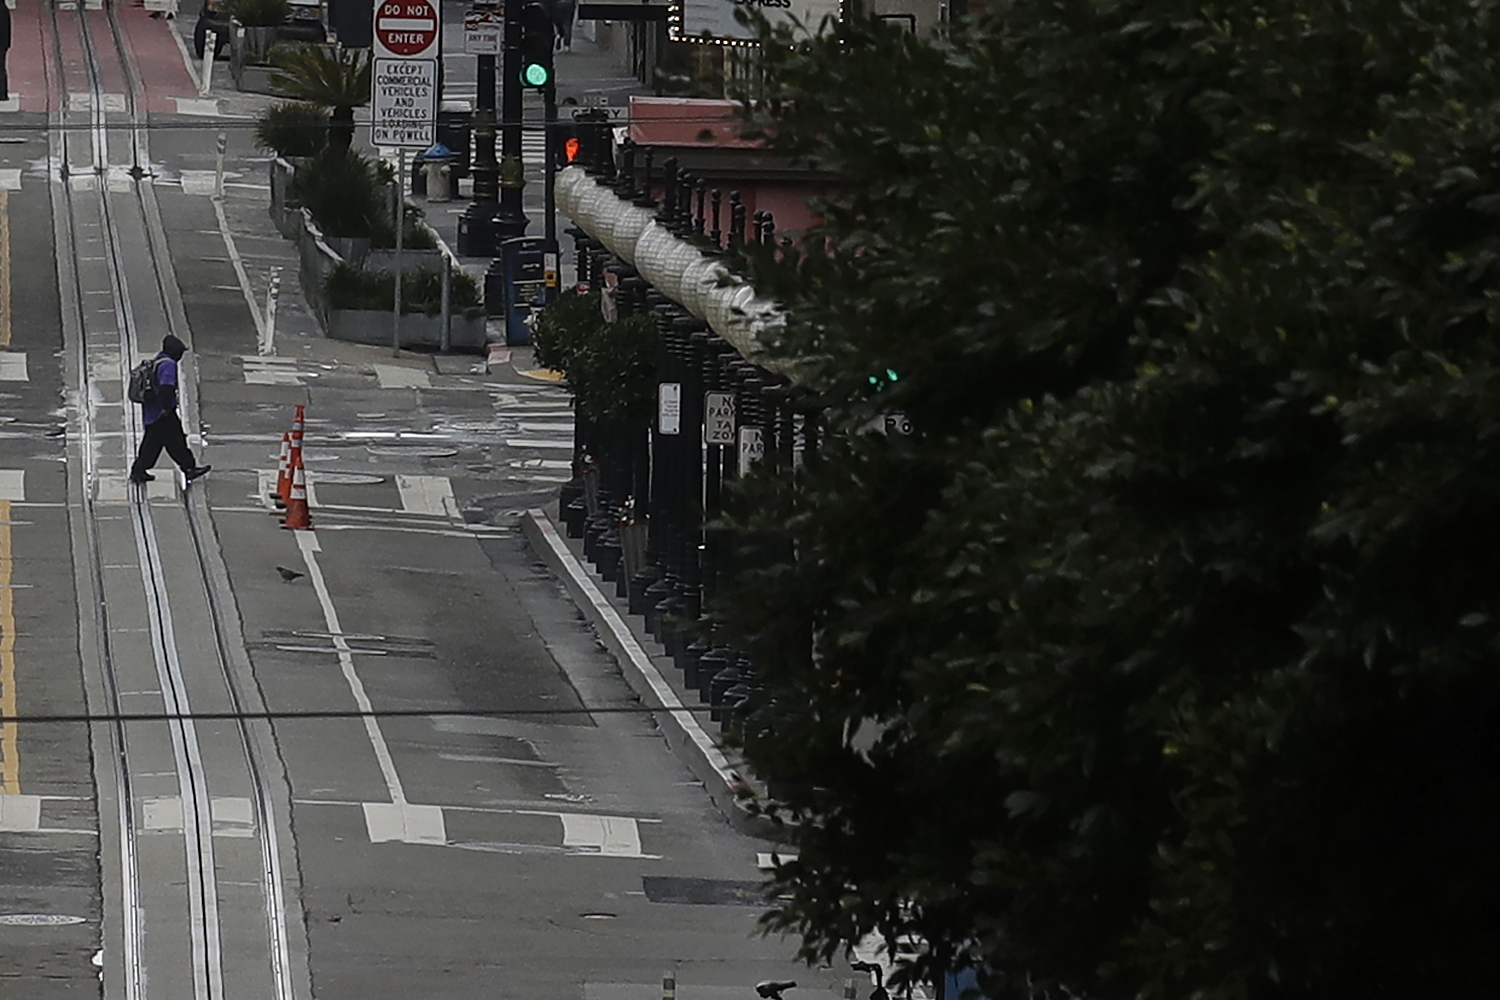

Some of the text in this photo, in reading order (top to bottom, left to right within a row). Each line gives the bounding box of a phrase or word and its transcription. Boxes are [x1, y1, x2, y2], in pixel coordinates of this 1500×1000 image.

[384, 4, 429, 17] DO NOT
[387, 33, 425, 45] ENTER
[386, 64, 424, 76] EXCEPT
[377, 75, 432, 87] COMMERCIAL
[381, 86, 428, 97] VEHICLES
[394, 97, 415, 108] AND
[380, 108, 428, 119] VEHICLES
[375, 129, 431, 142] ON POWELL
[716, 420, 732, 430] TA
